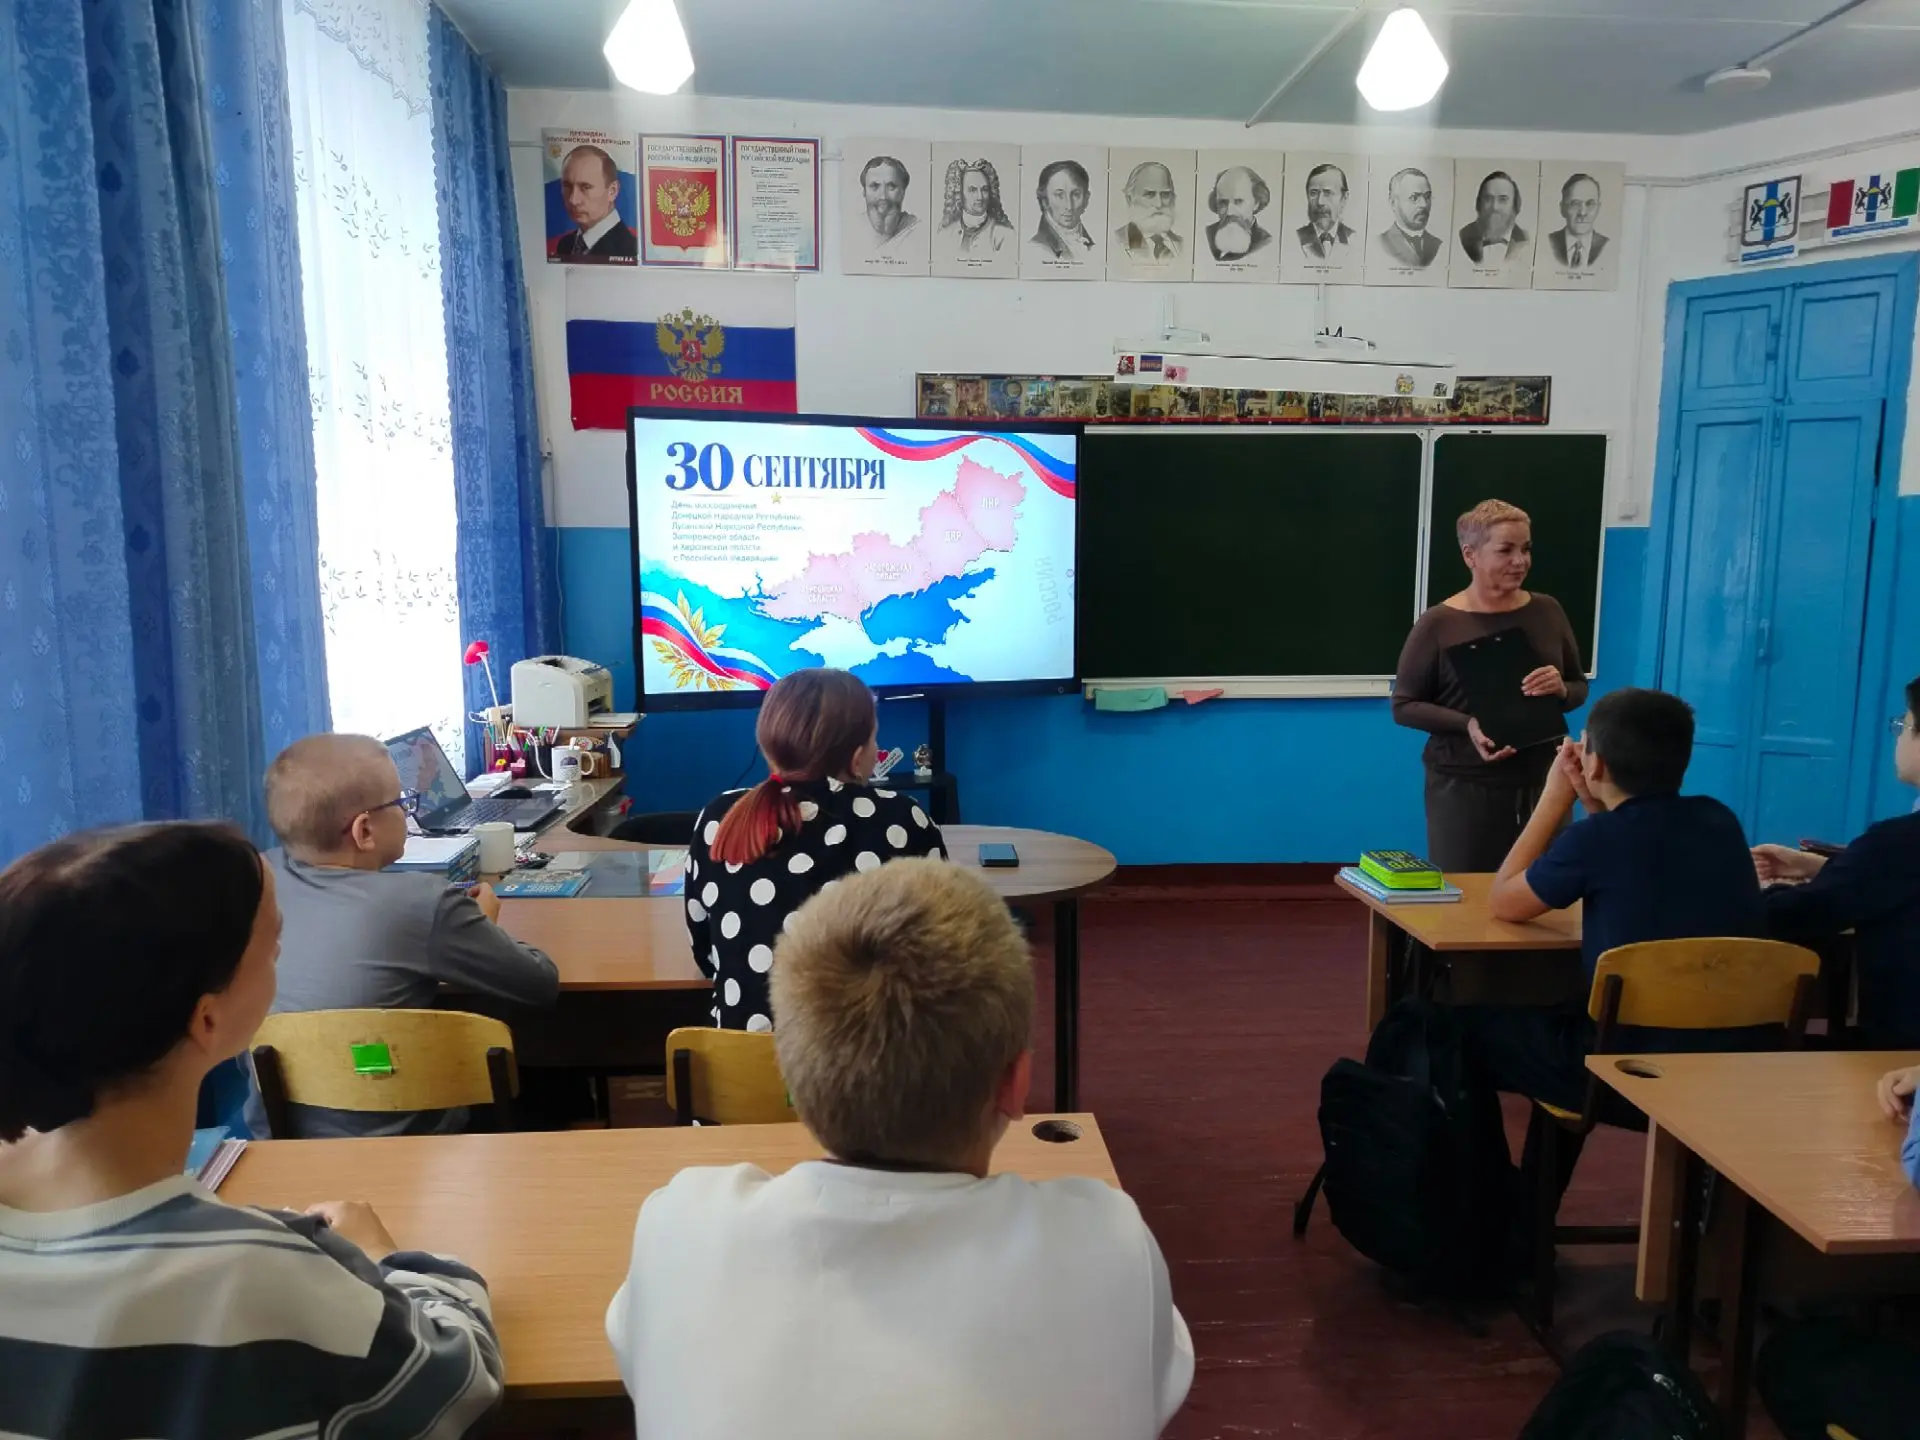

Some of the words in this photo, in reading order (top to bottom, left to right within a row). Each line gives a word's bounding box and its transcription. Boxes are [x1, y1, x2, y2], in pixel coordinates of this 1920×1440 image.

[650, 383, 744, 405] РОССИЯ
[665, 441, 735, 491] 30
[743, 454, 886, 490] СЕНТЯБРЯ
